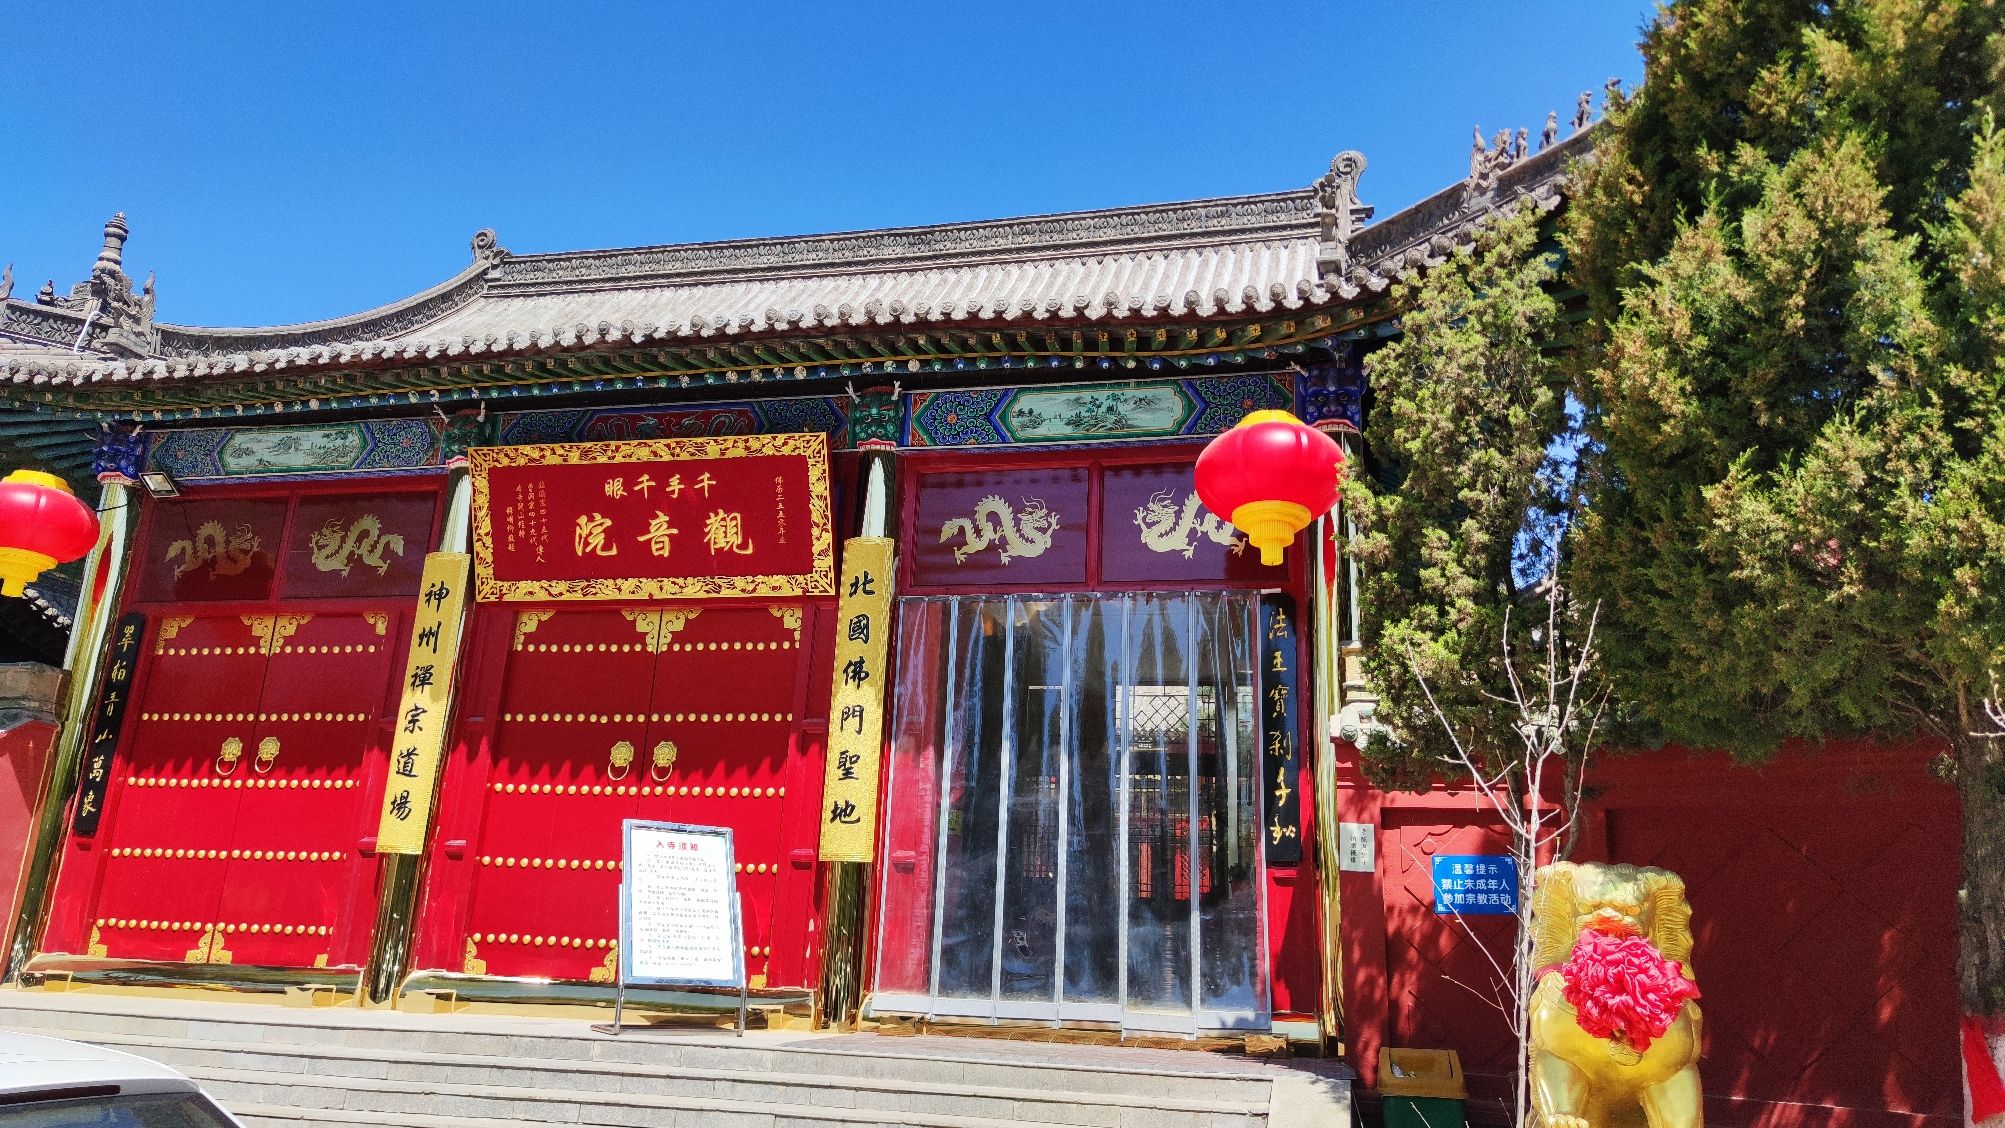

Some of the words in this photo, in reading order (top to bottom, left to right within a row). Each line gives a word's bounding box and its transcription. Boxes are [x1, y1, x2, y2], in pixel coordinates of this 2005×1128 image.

[604, 471, 716, 499] 千手千眼
[575, 508, 755, 557] 觀音院
[390, 579, 450, 822] 神州禪宗道場
[829, 570, 876, 826] 北國佛門聖地
[1451, 863, 1498, 875] 温馨提示
[1441, 878, 1510, 891] 禁止未成年人
[1442, 892, 1512, 906] 参加宗教活动
